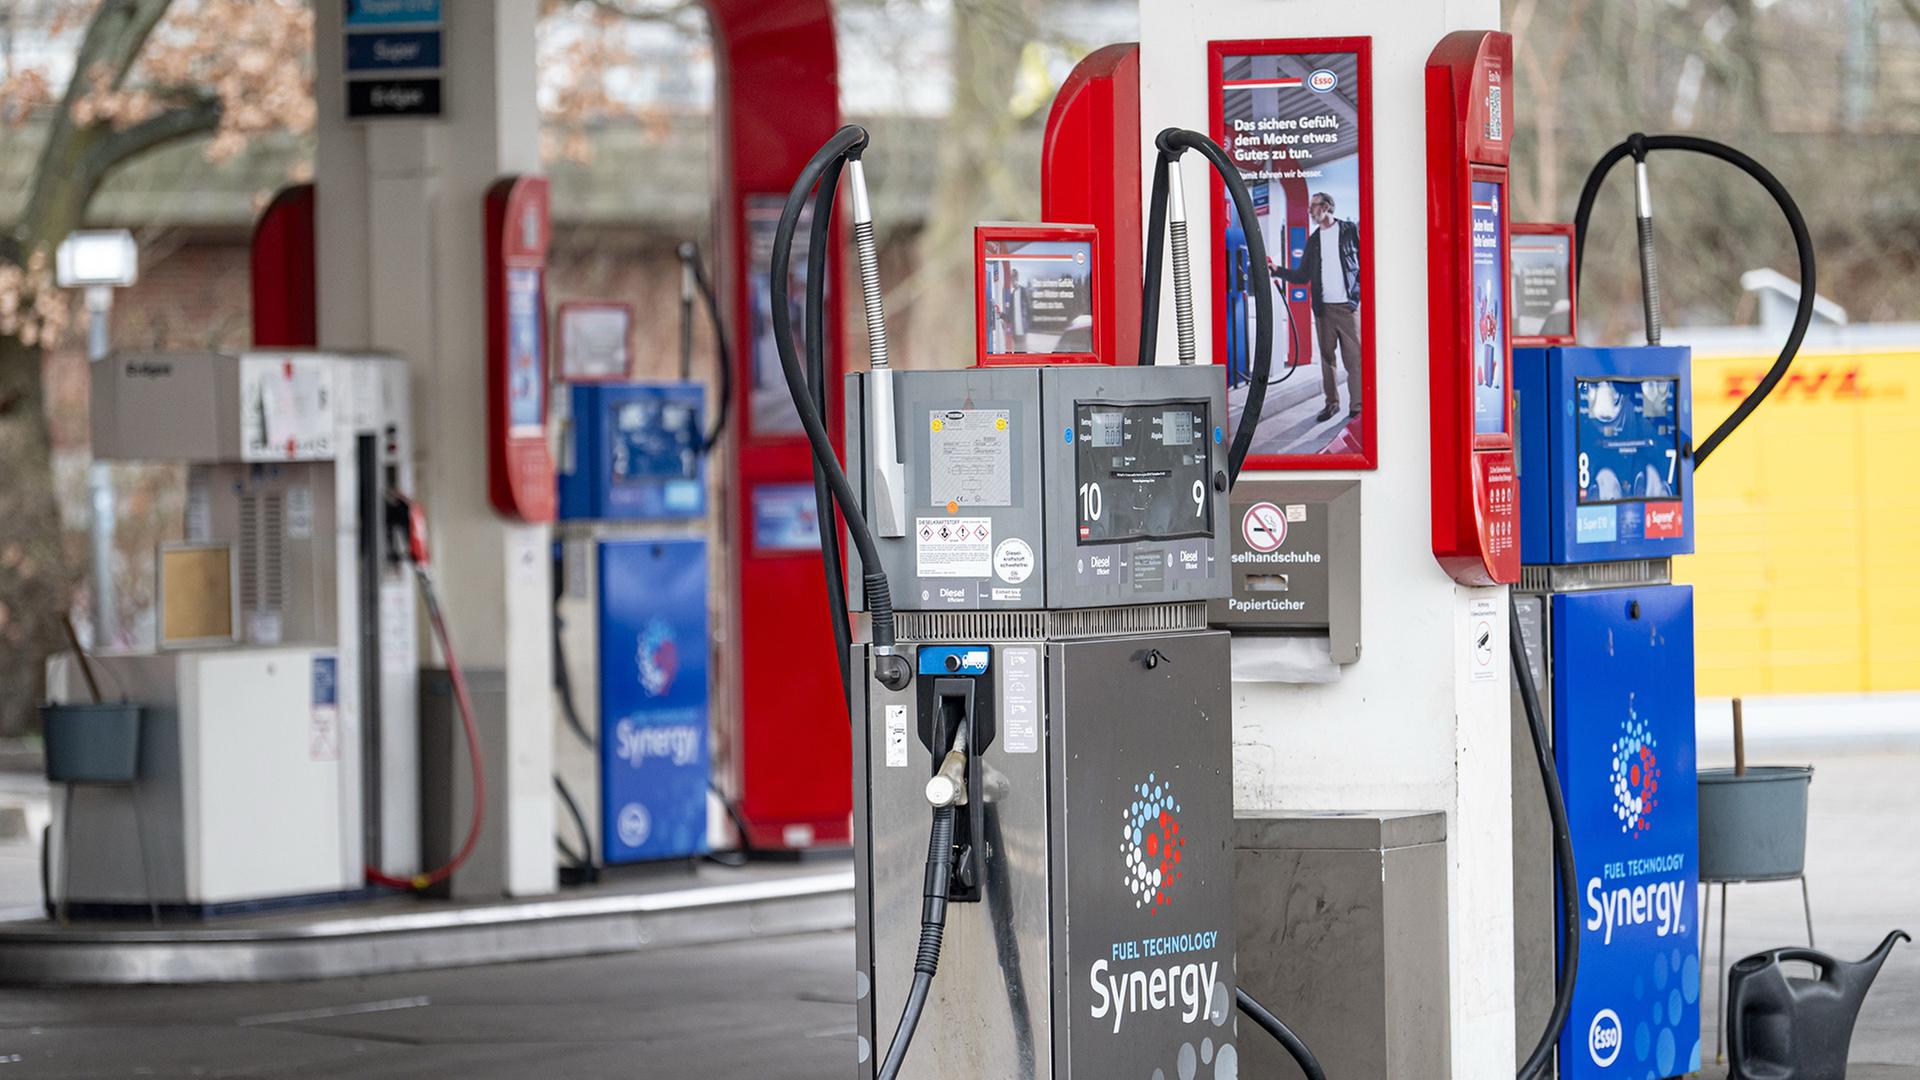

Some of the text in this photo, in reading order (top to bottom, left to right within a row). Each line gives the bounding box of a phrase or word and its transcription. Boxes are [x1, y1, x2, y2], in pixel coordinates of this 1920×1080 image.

[1313, 75, 1332, 85] Esso
[1234, 115, 1339, 131] Das sichere Gefühl,
[1234, 132, 1338, 146] dem Motor etwas
[1235, 149, 1312, 161] Gutes zu tun.
[1259, 169, 1283, 179] fahren
[1284, 170, 1297, 178] wir
[1298, 169, 1323, 178] besser.
[1579, 452, 1590, 488] 8
[1665, 449, 1677, 484] 7
[1079, 482, 1102, 521] 10
[1192, 480, 1205, 517] 9
[1090, 556, 1110, 568] Diesel
[1180, 550, 1198, 562] Diesel
[1231, 551, 1321, 563] selhandschuhe
[940, 588, 965, 598] Diesel
[1228, 598, 1305, 612] Papiertücher
[616, 717, 698, 769] Synergy
[1604, 853, 1684, 879] FUEL TECHNOLOGY
[1586, 877, 1685, 945] Synergy
[1112, 930, 1218, 961] FUEL TECHNOLOGY
[1090, 958, 1218, 1034] Synergy
[1592, 1025, 1617, 1050] Esso
